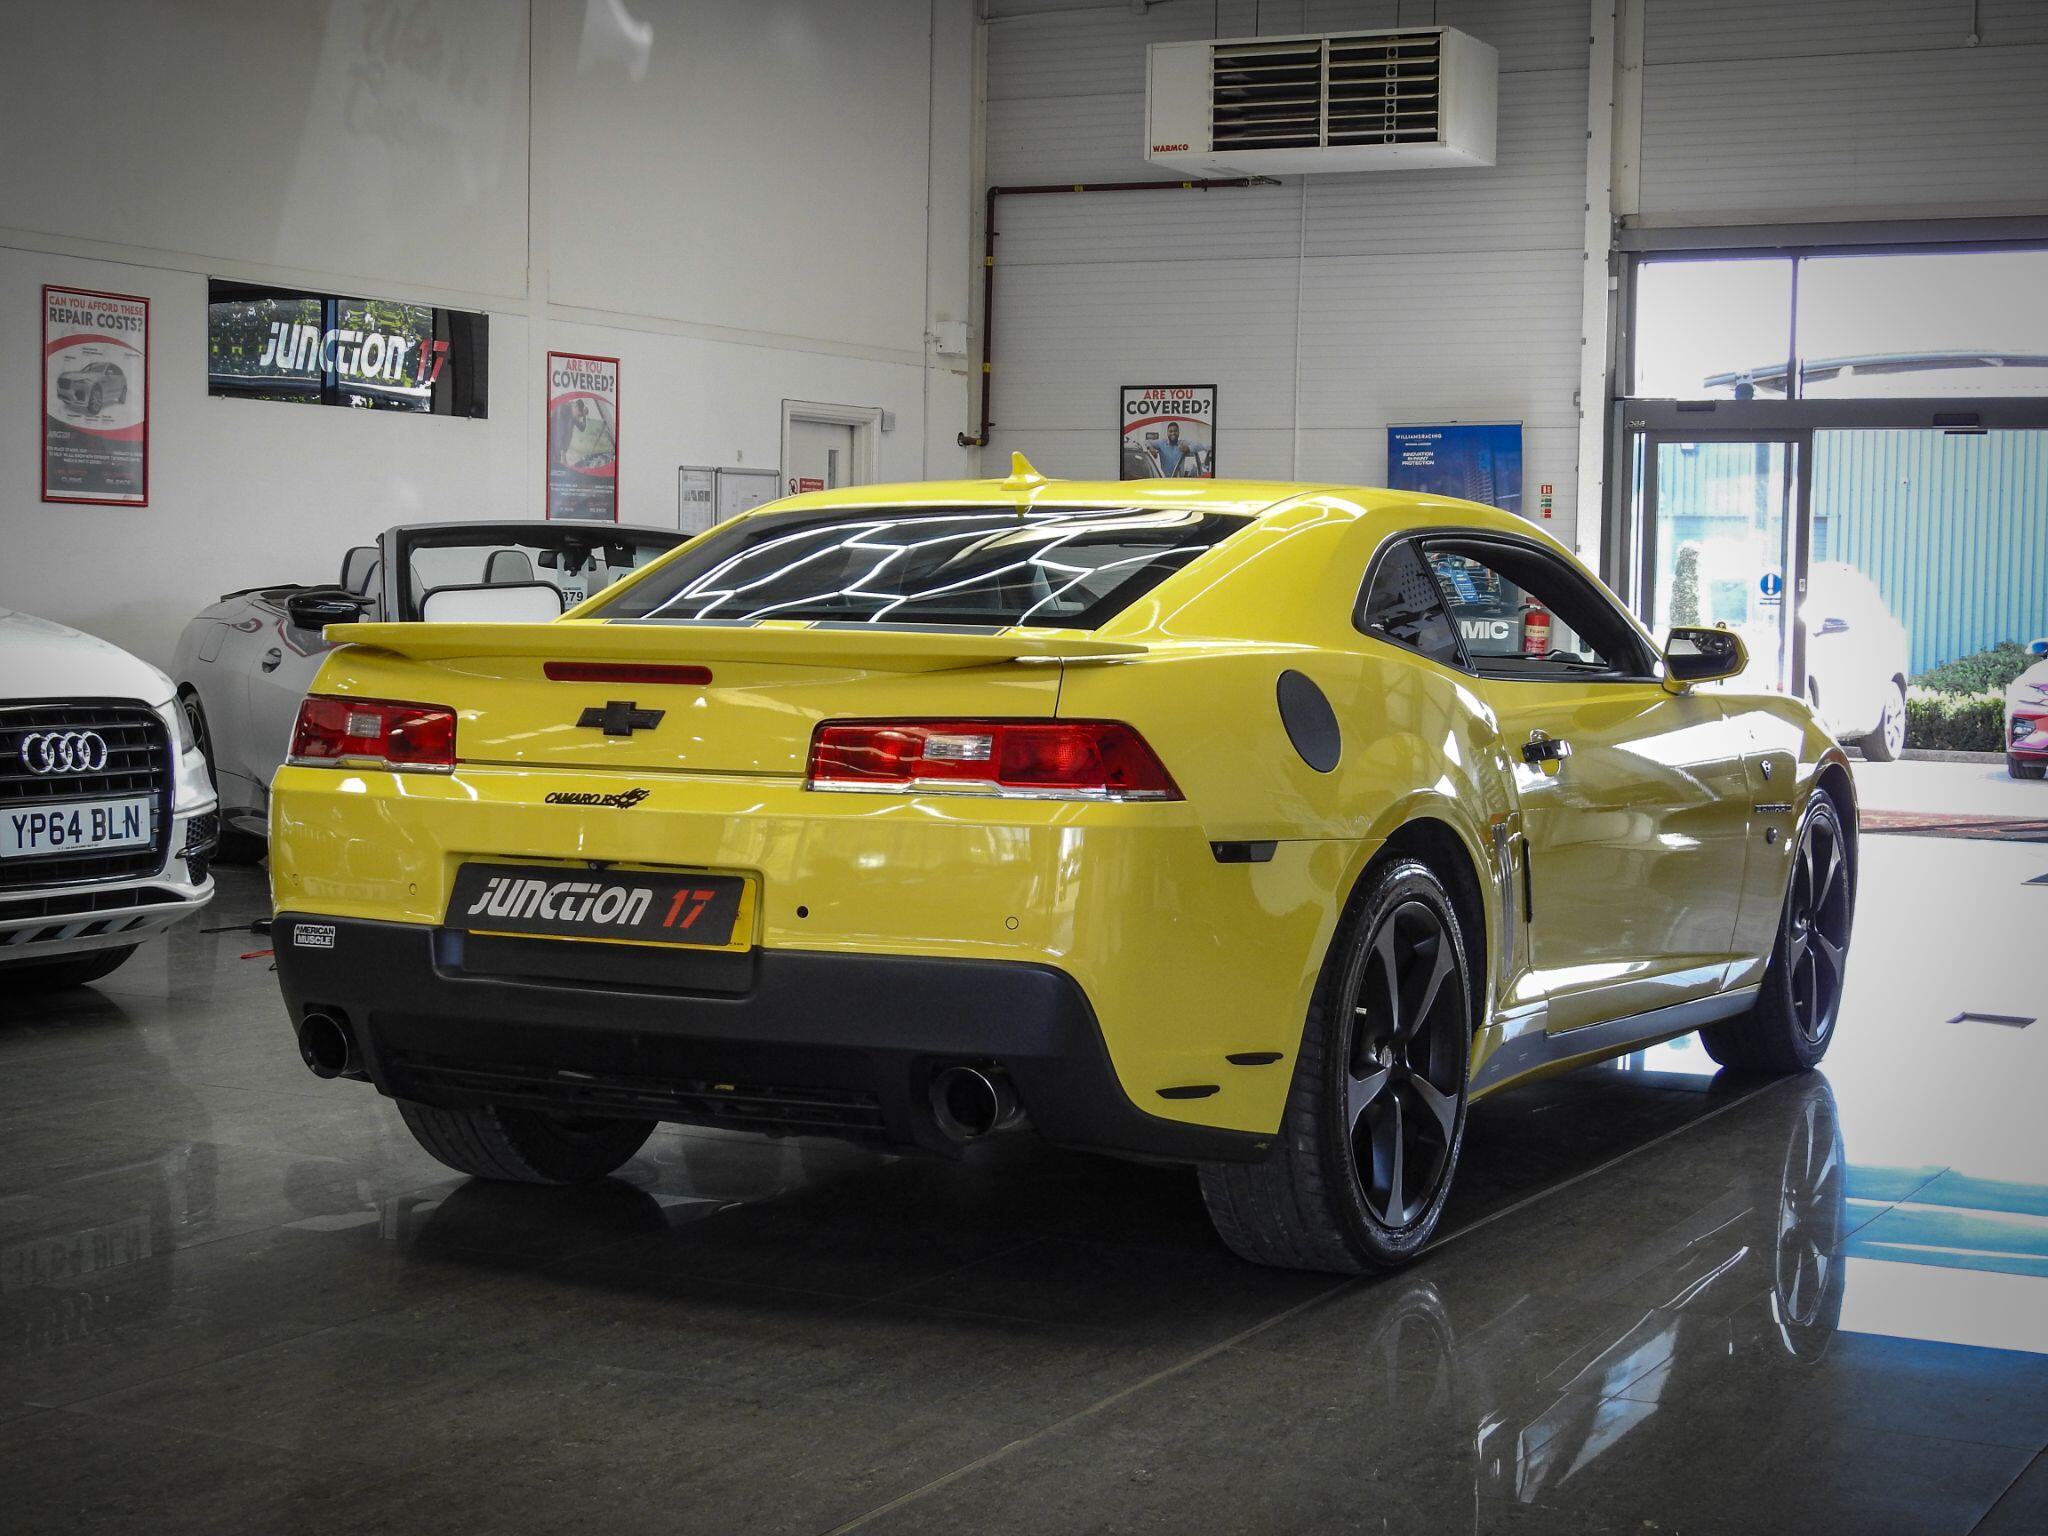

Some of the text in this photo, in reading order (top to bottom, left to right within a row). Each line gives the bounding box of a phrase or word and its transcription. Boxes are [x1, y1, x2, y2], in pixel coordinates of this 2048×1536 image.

[1152, 143, 1189, 153] WARMCO
[49, 295, 144, 316] CAN YOU AFFORD THESE
[49, 307, 143, 332] REPAIR COSTS?
[259, 321, 450, 383] JUNCTION 17
[565, 358, 603, 374] ARE YOU
[552, 369, 615, 393] COVERED?
[1143, 389, 1194, 400] ARE YOU
[1126, 399, 1211, 415] COVERED?
[544, 791, 600, 805] CAMARO
[11, 804, 140, 849] YP64 BLN
[467, 877, 716, 929] JUNCTION 17
[296, 925, 336, 936] AMERICAN
[297, 934, 332, 945] MUSCLE
